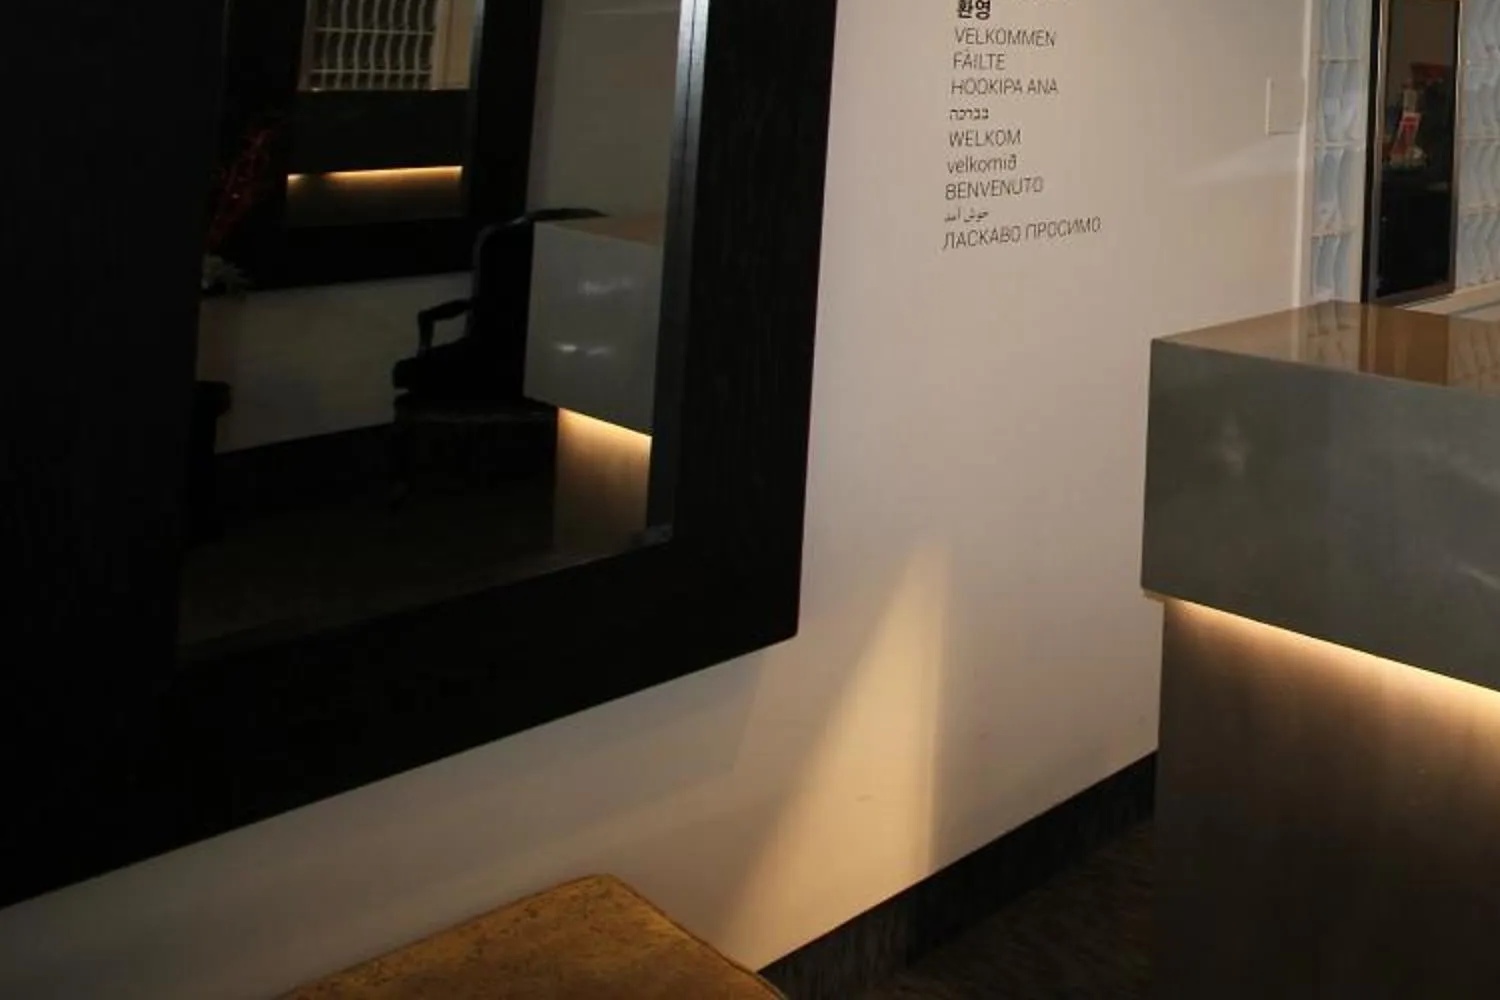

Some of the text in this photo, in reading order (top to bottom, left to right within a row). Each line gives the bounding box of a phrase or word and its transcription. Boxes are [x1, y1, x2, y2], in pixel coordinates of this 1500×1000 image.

[954, 27, 1056, 47] VELKOMMEN
[951, 77, 1059, 96] HOOKIPA ANA
[949, 129, 1021, 148] WELKOM
[945, 176, 1044, 201] BENVENUTO
[943, 216, 1101, 251] ЛАСКАВО ПРОСИМО
